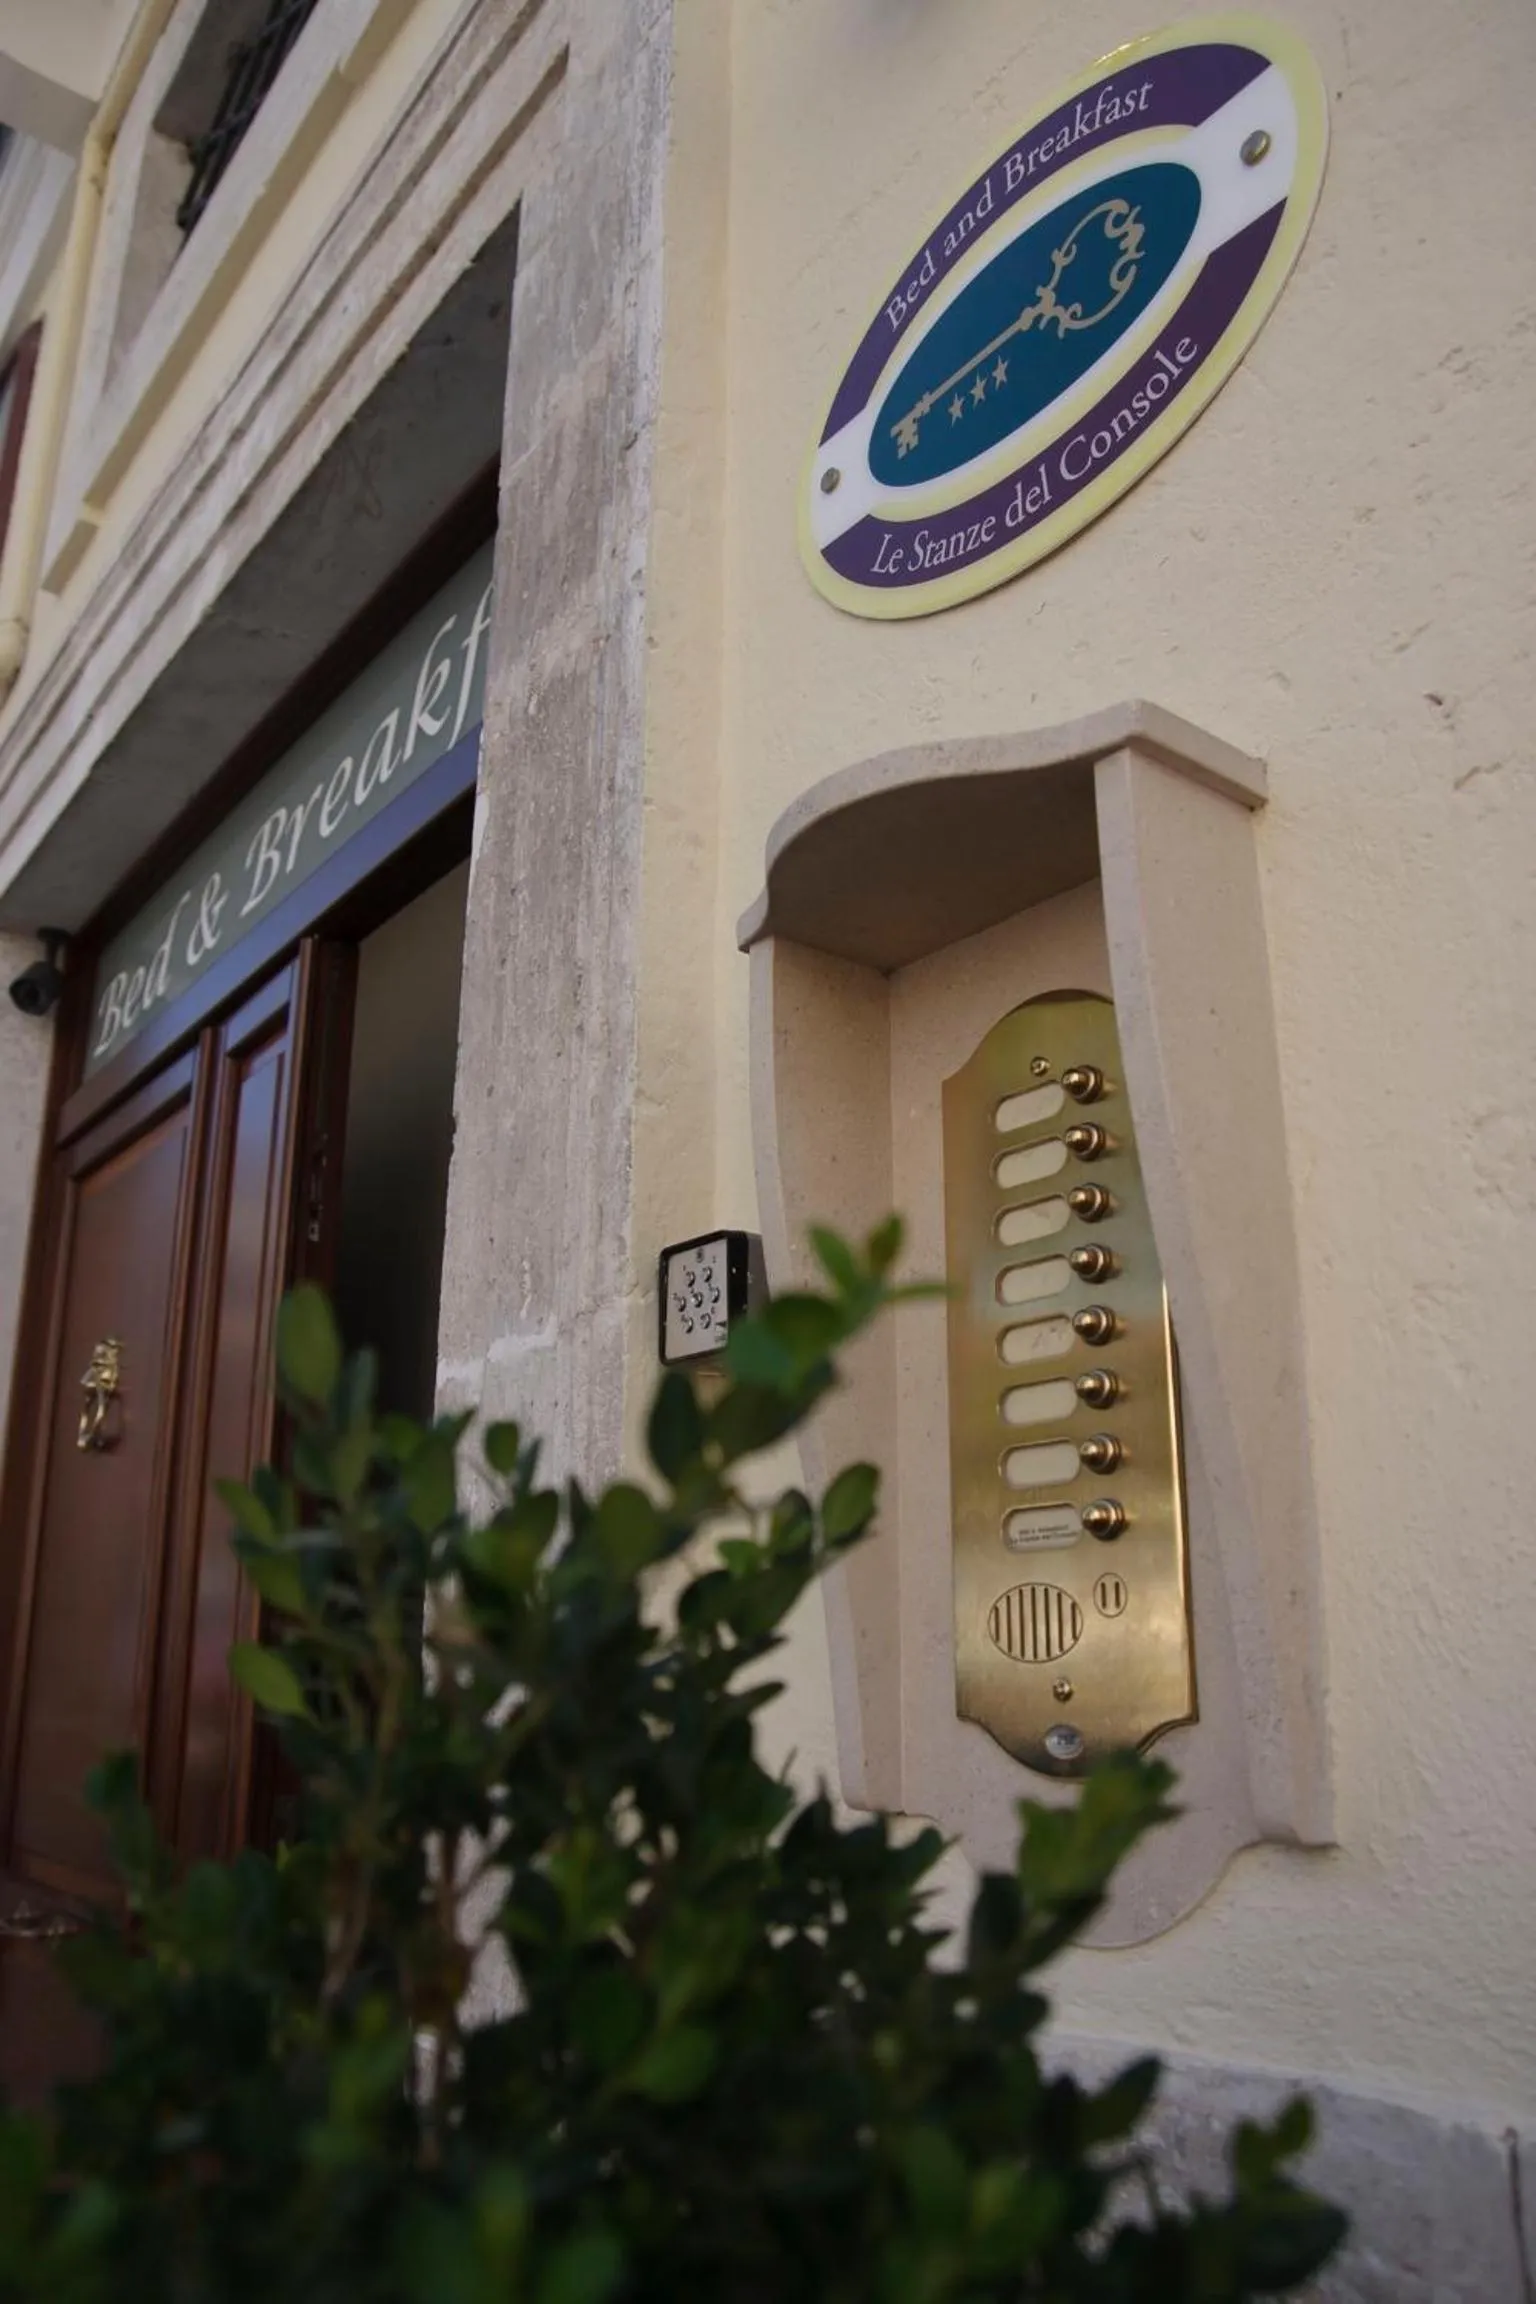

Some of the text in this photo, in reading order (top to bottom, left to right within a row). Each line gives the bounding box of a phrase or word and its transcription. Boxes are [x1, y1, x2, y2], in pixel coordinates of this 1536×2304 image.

[885, 81, 1154, 332] Bed and Breakfast
[871, 336, 1198, 574] Le Stanze del Console
[93, 888, 191, 1058] Bed
[186, 871, 229, 966] &
